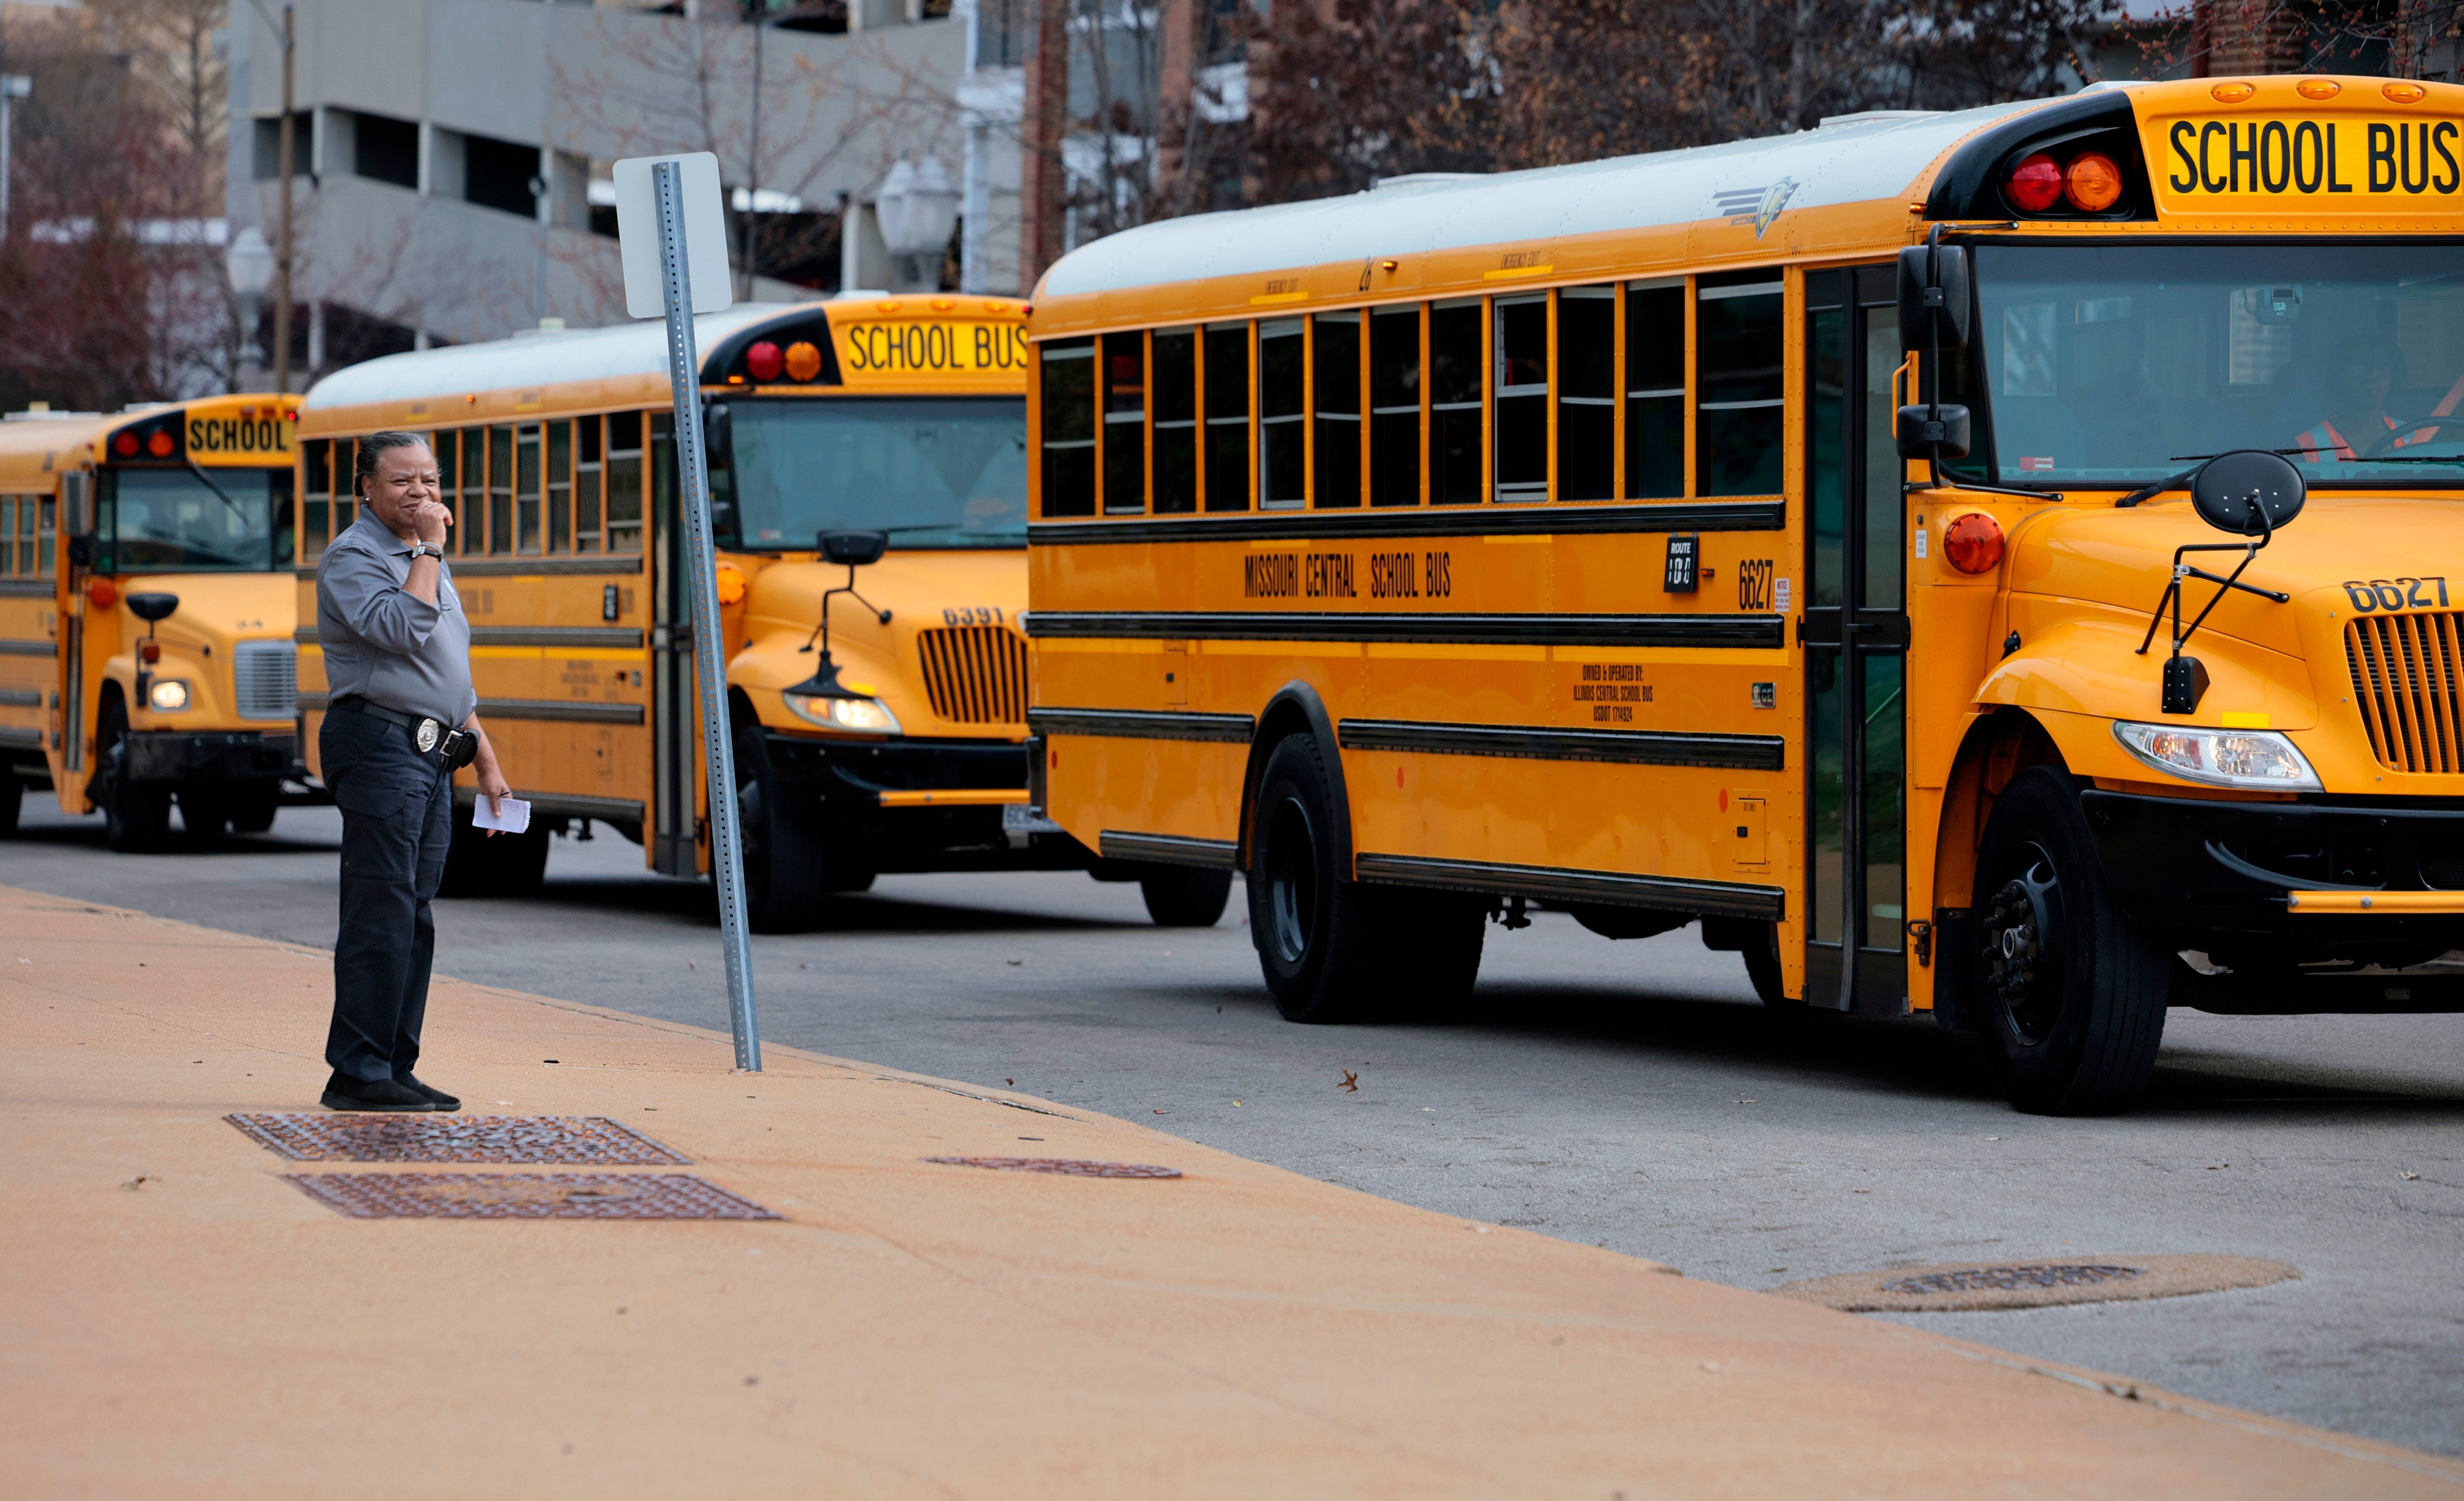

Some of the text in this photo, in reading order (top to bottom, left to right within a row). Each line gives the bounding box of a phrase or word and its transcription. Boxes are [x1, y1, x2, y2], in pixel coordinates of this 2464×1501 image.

[2170, 121, 2460, 194] SCHOOL BUS
[1359, 255, 1377, 291] 26
[851, 324, 1028, 369] SCHOOL BUS
[190, 419, 287, 451] SCHOOL
[1671, 542, 1691, 554] ROUTE
[1245, 552, 1451, 598] MISSOURI CENTRAL SCHOOL BUS
[1739, 559, 1773, 610] 6627
[2342, 577, 2449, 613] 6627
[943, 606, 1003, 626] 6391
[1583, 665, 1601, 681] OWNED
[1603, 666, 1607, 681] &
[1608, 665, 1634, 681] OPERATED
[1573, 685, 1653, 702] ILLINOIS CENTRAL SCHOOL BUS
[1594, 706, 1632, 722] USDOT 1714924
